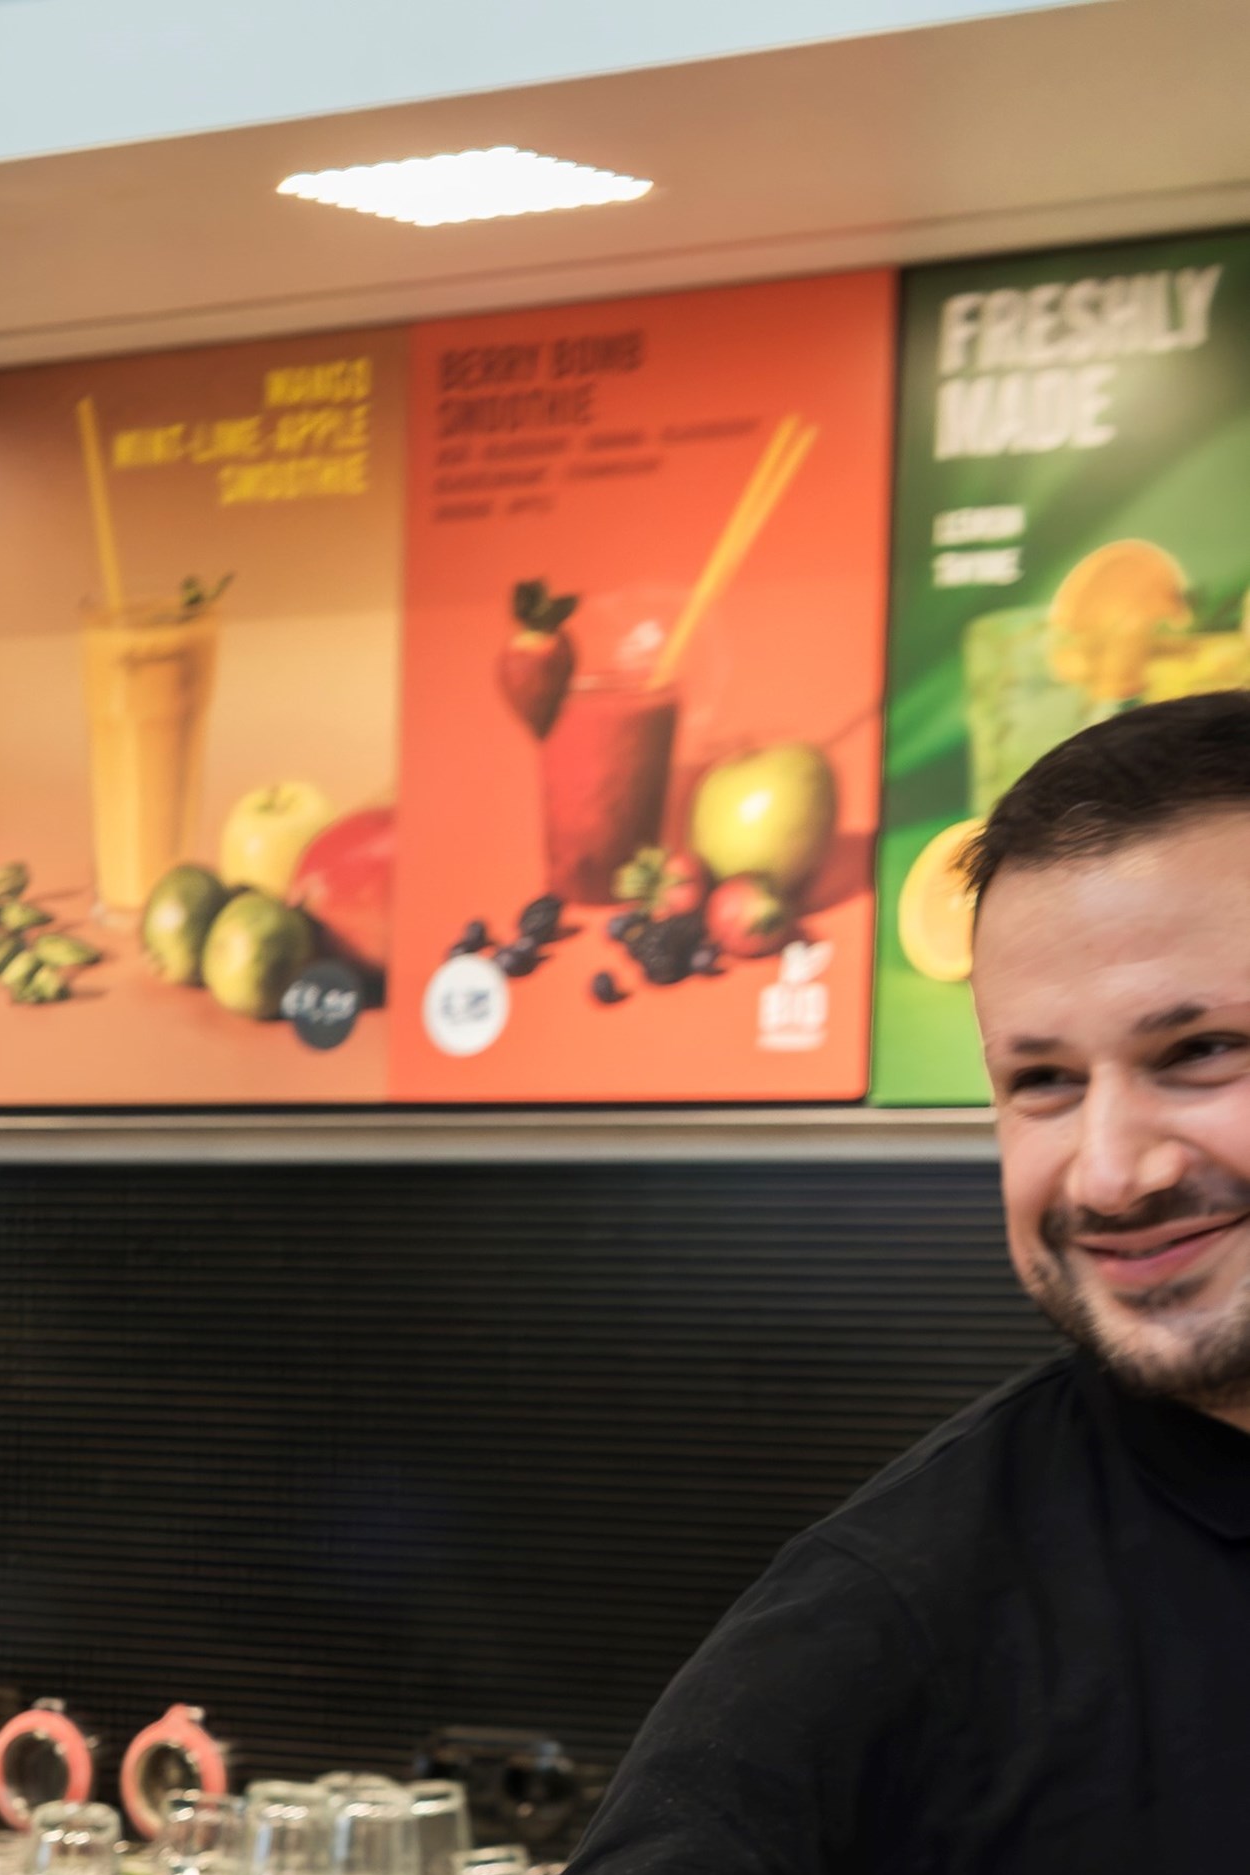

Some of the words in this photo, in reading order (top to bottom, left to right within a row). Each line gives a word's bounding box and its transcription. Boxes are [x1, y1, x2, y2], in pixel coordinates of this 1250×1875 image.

[940, 264, 1223, 374] FRESHLY
[440, 345, 541, 392] BERRY
[439, 382, 595, 438] SMOOTHIE
[935, 363, 1118, 461] MADE
